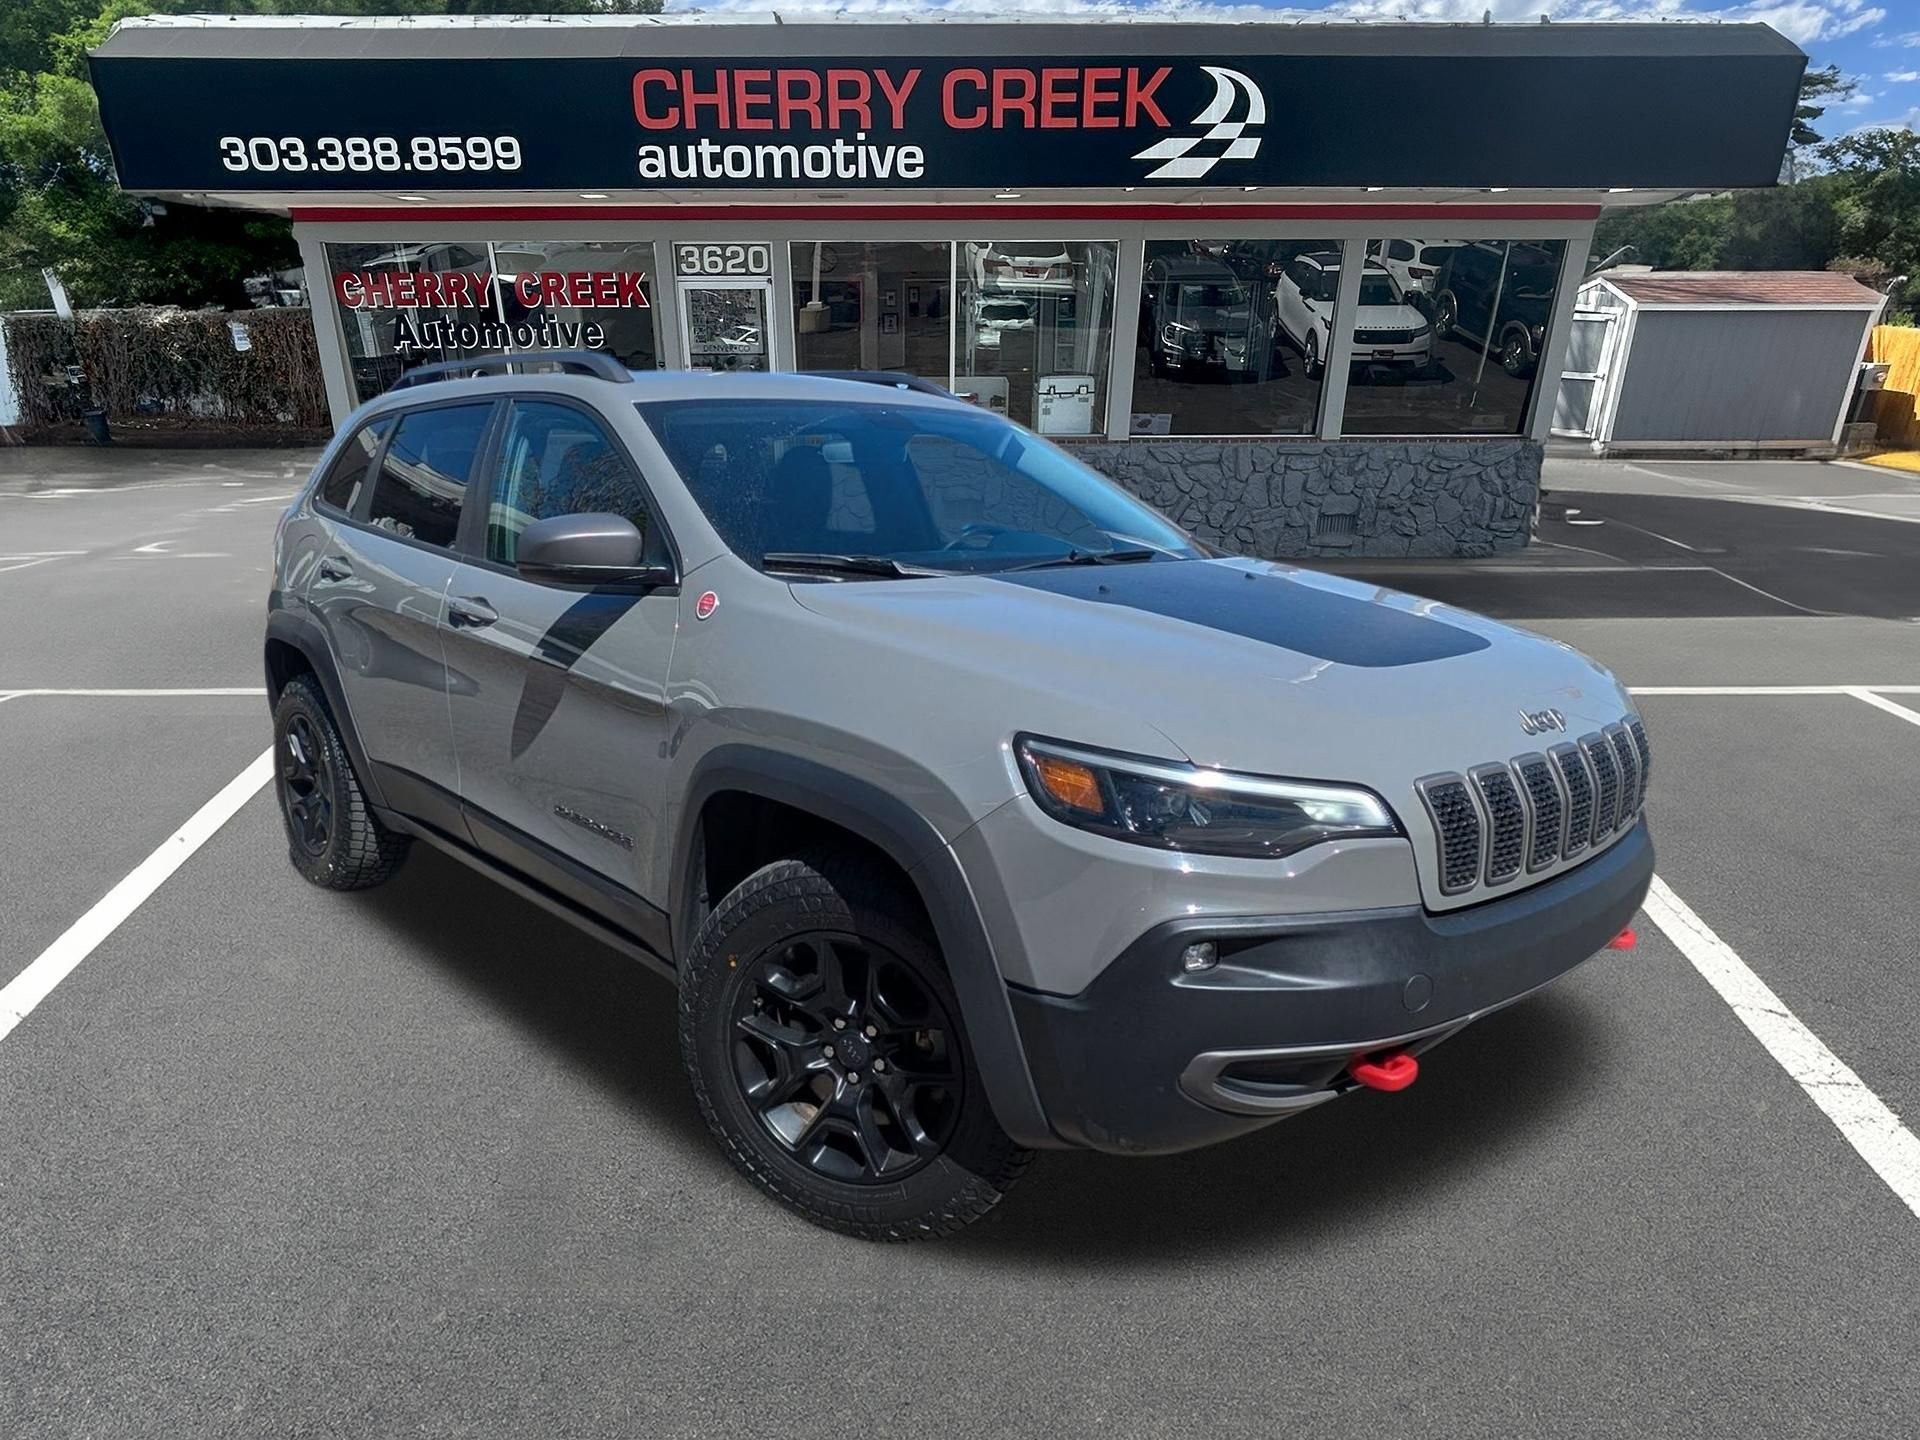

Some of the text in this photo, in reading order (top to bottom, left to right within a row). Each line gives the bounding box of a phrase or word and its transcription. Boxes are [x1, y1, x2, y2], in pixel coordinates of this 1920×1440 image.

[633, 67, 1173, 130] CHERRY CREEK
[219, 136, 522, 172] 303.388.8599
[638, 132, 925, 179] automotive
[680, 246, 769, 274] 3620
[335, 271, 650, 309] CHERRY CREEK
[394, 314, 605, 349] Automotive
[1519, 708, 1566, 735] Jeep
